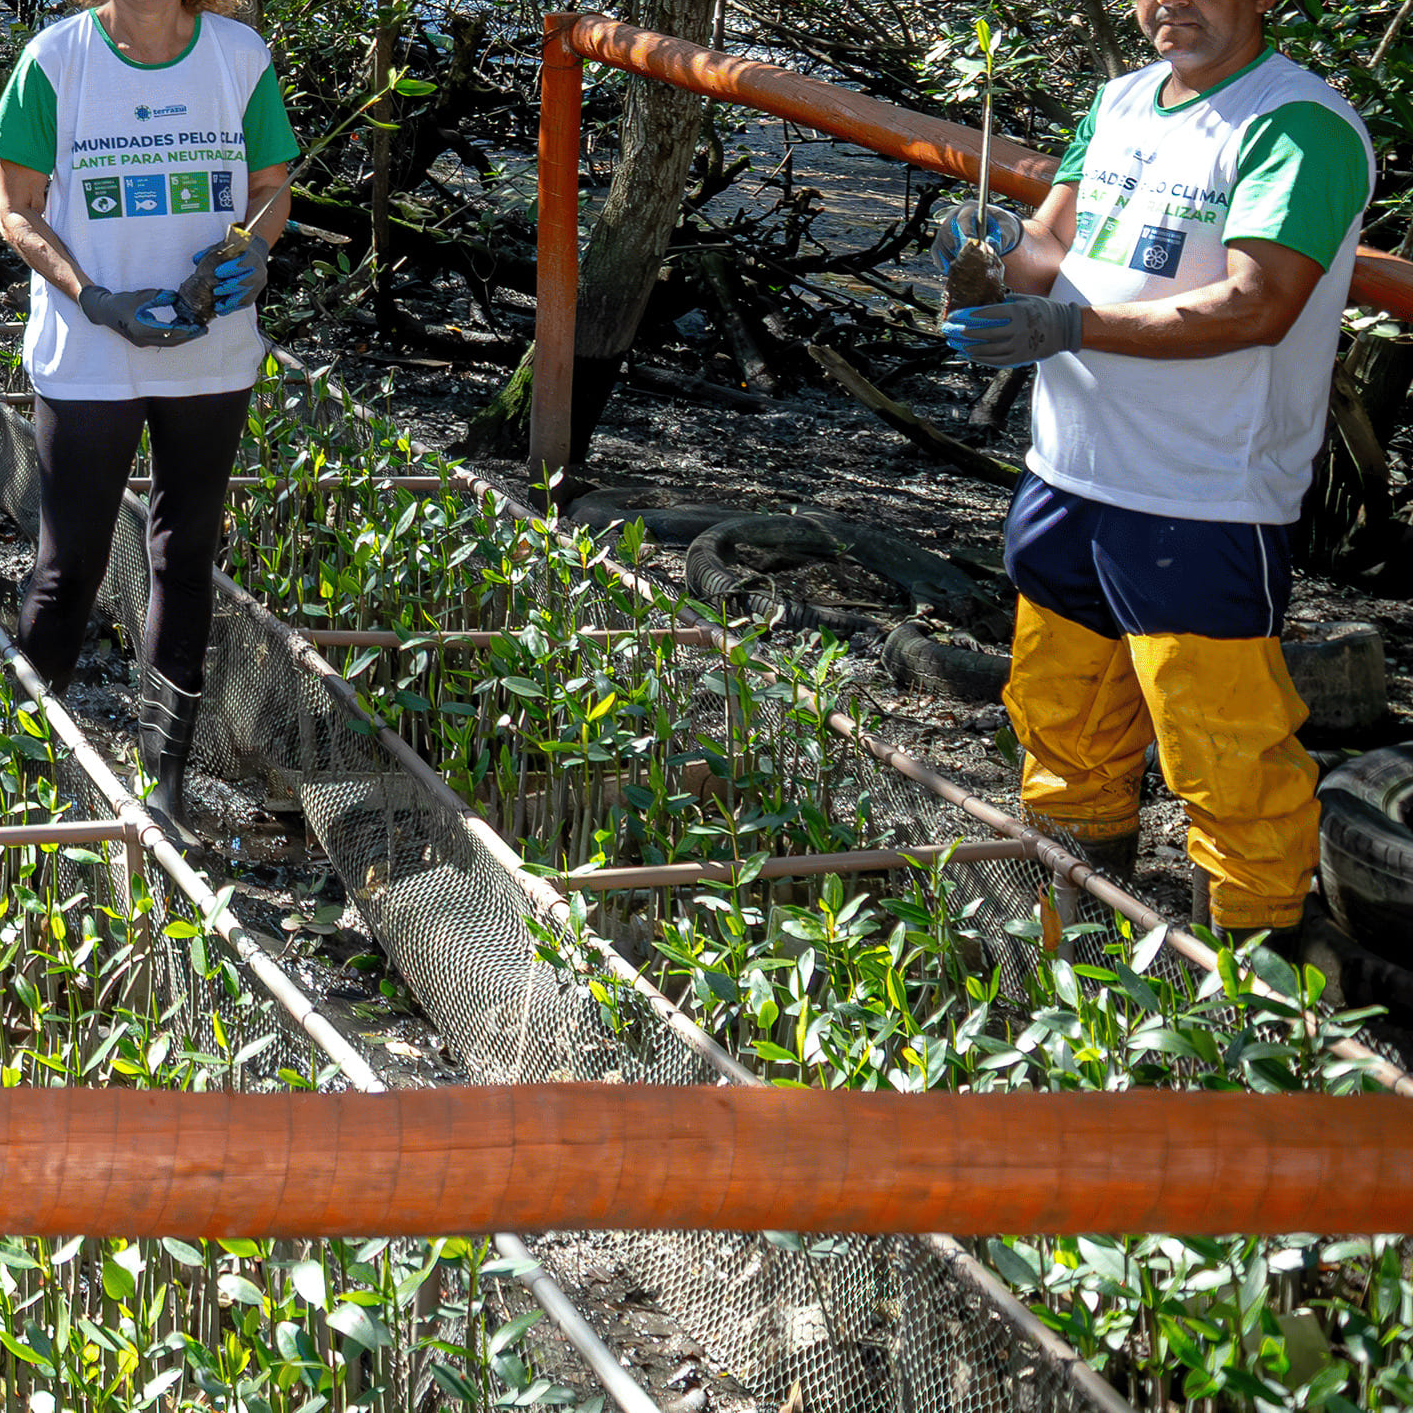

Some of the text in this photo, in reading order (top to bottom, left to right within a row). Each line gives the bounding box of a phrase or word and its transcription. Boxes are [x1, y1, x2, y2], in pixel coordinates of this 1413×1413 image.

[178, 132, 217, 145] PELO
[72, 155, 116, 170] LANTE
[122, 153, 164, 165] PARA
[1171, 184, 1229, 207] CLIMA
